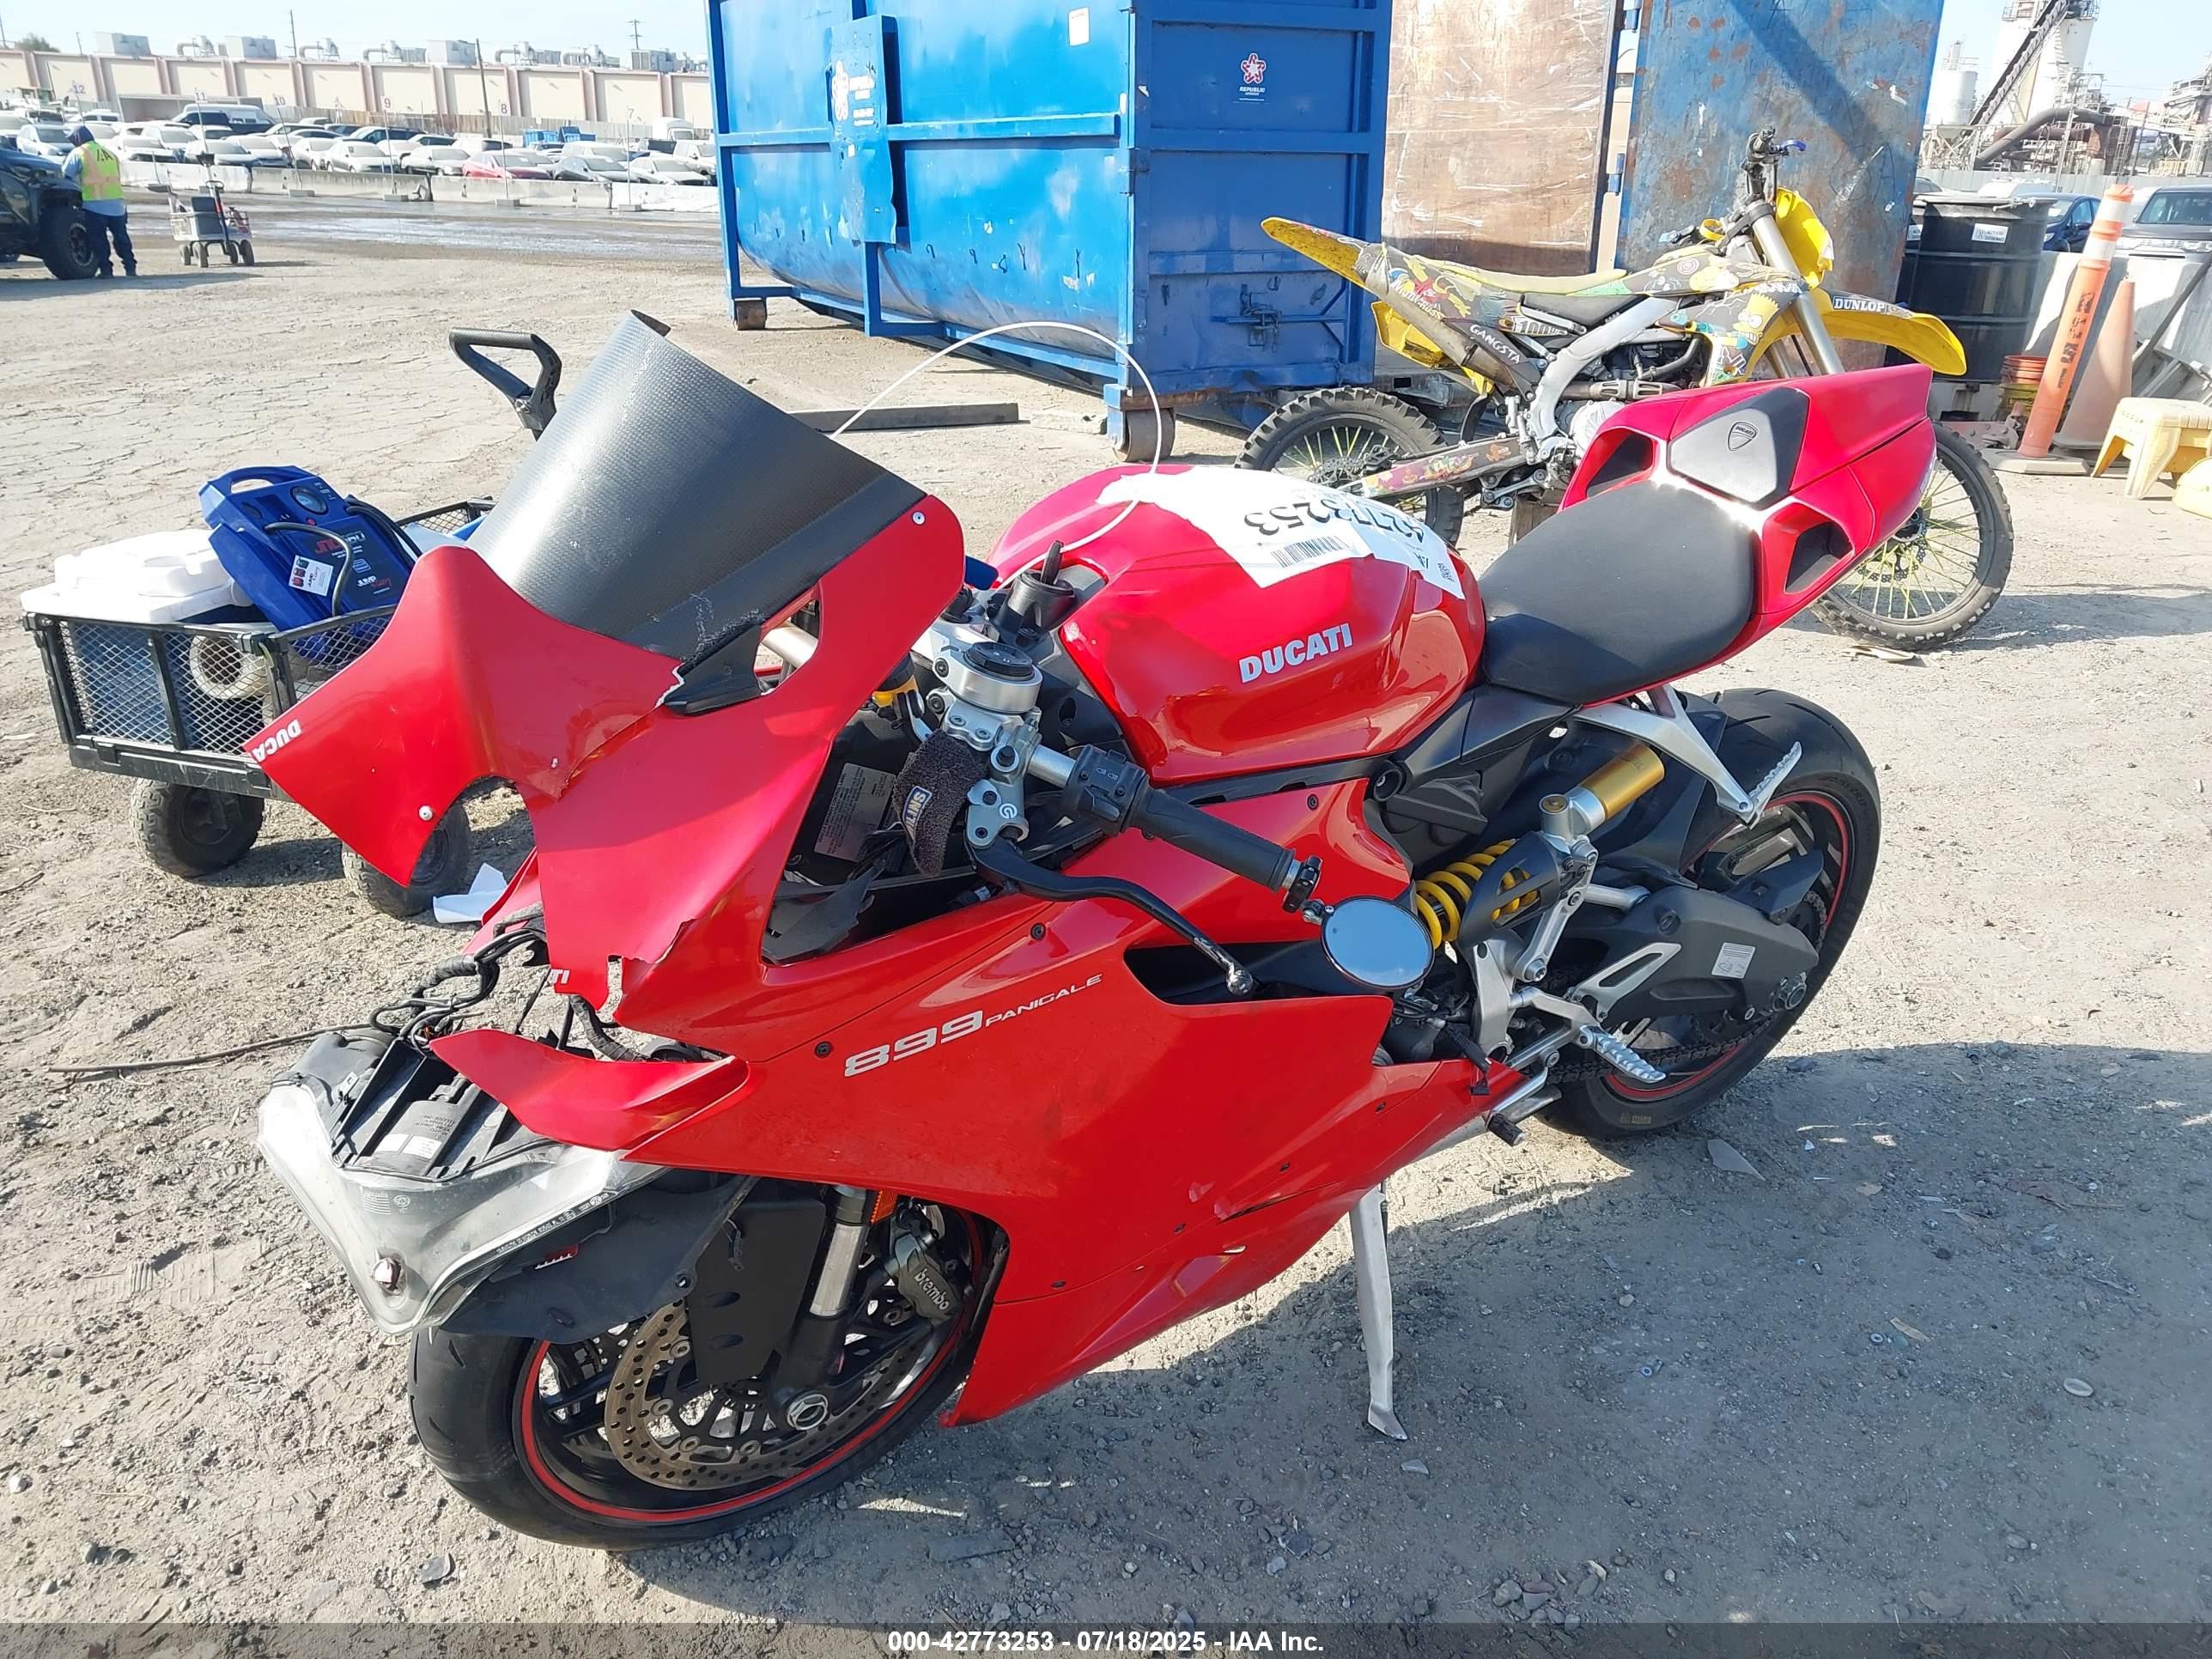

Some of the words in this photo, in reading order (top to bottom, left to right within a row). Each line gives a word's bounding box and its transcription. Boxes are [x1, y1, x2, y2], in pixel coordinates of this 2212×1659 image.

[274, 96, 287, 106] 10
[384, 97, 392, 108] 9
[501, 103, 508, 114] 8
[628, 108, 635, 118] 7
[1833, 297, 1886, 313] DUNLOP
[1469, 323, 1521, 364] GANGSTA
[1239, 623, 1352, 684] DUCATI
[844, 1010, 983, 1078] 899
[985, 973, 1103, 1028] PANIGALE
[913, 1267, 951, 1311] brembo
